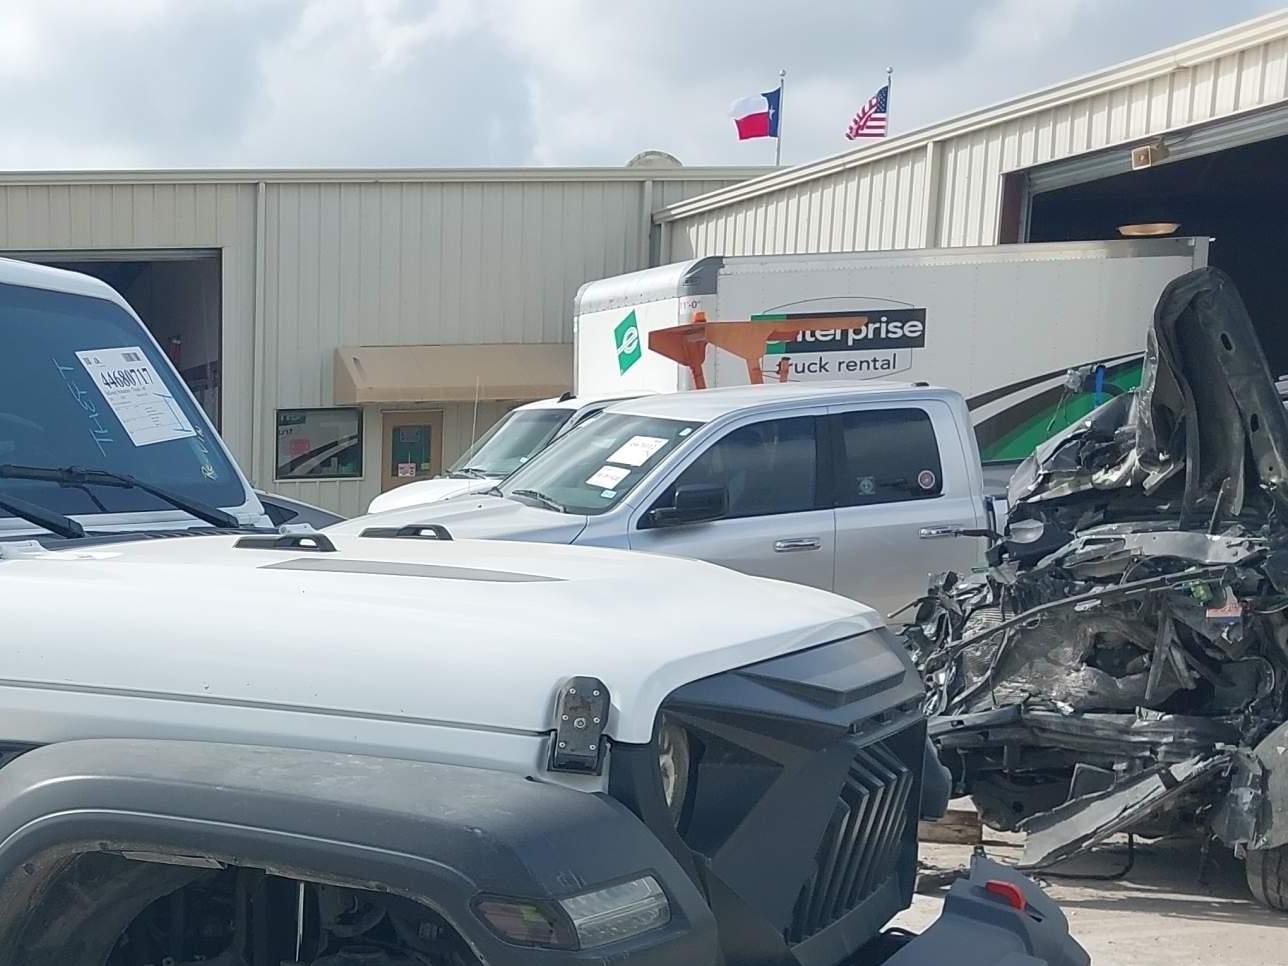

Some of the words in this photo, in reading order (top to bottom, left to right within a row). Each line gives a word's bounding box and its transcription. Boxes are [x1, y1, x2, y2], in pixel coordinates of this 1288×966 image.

[769, 316, 924, 346] terprise
[838, 352, 897, 373] rental
[100, 366, 154, 390] 44680717
